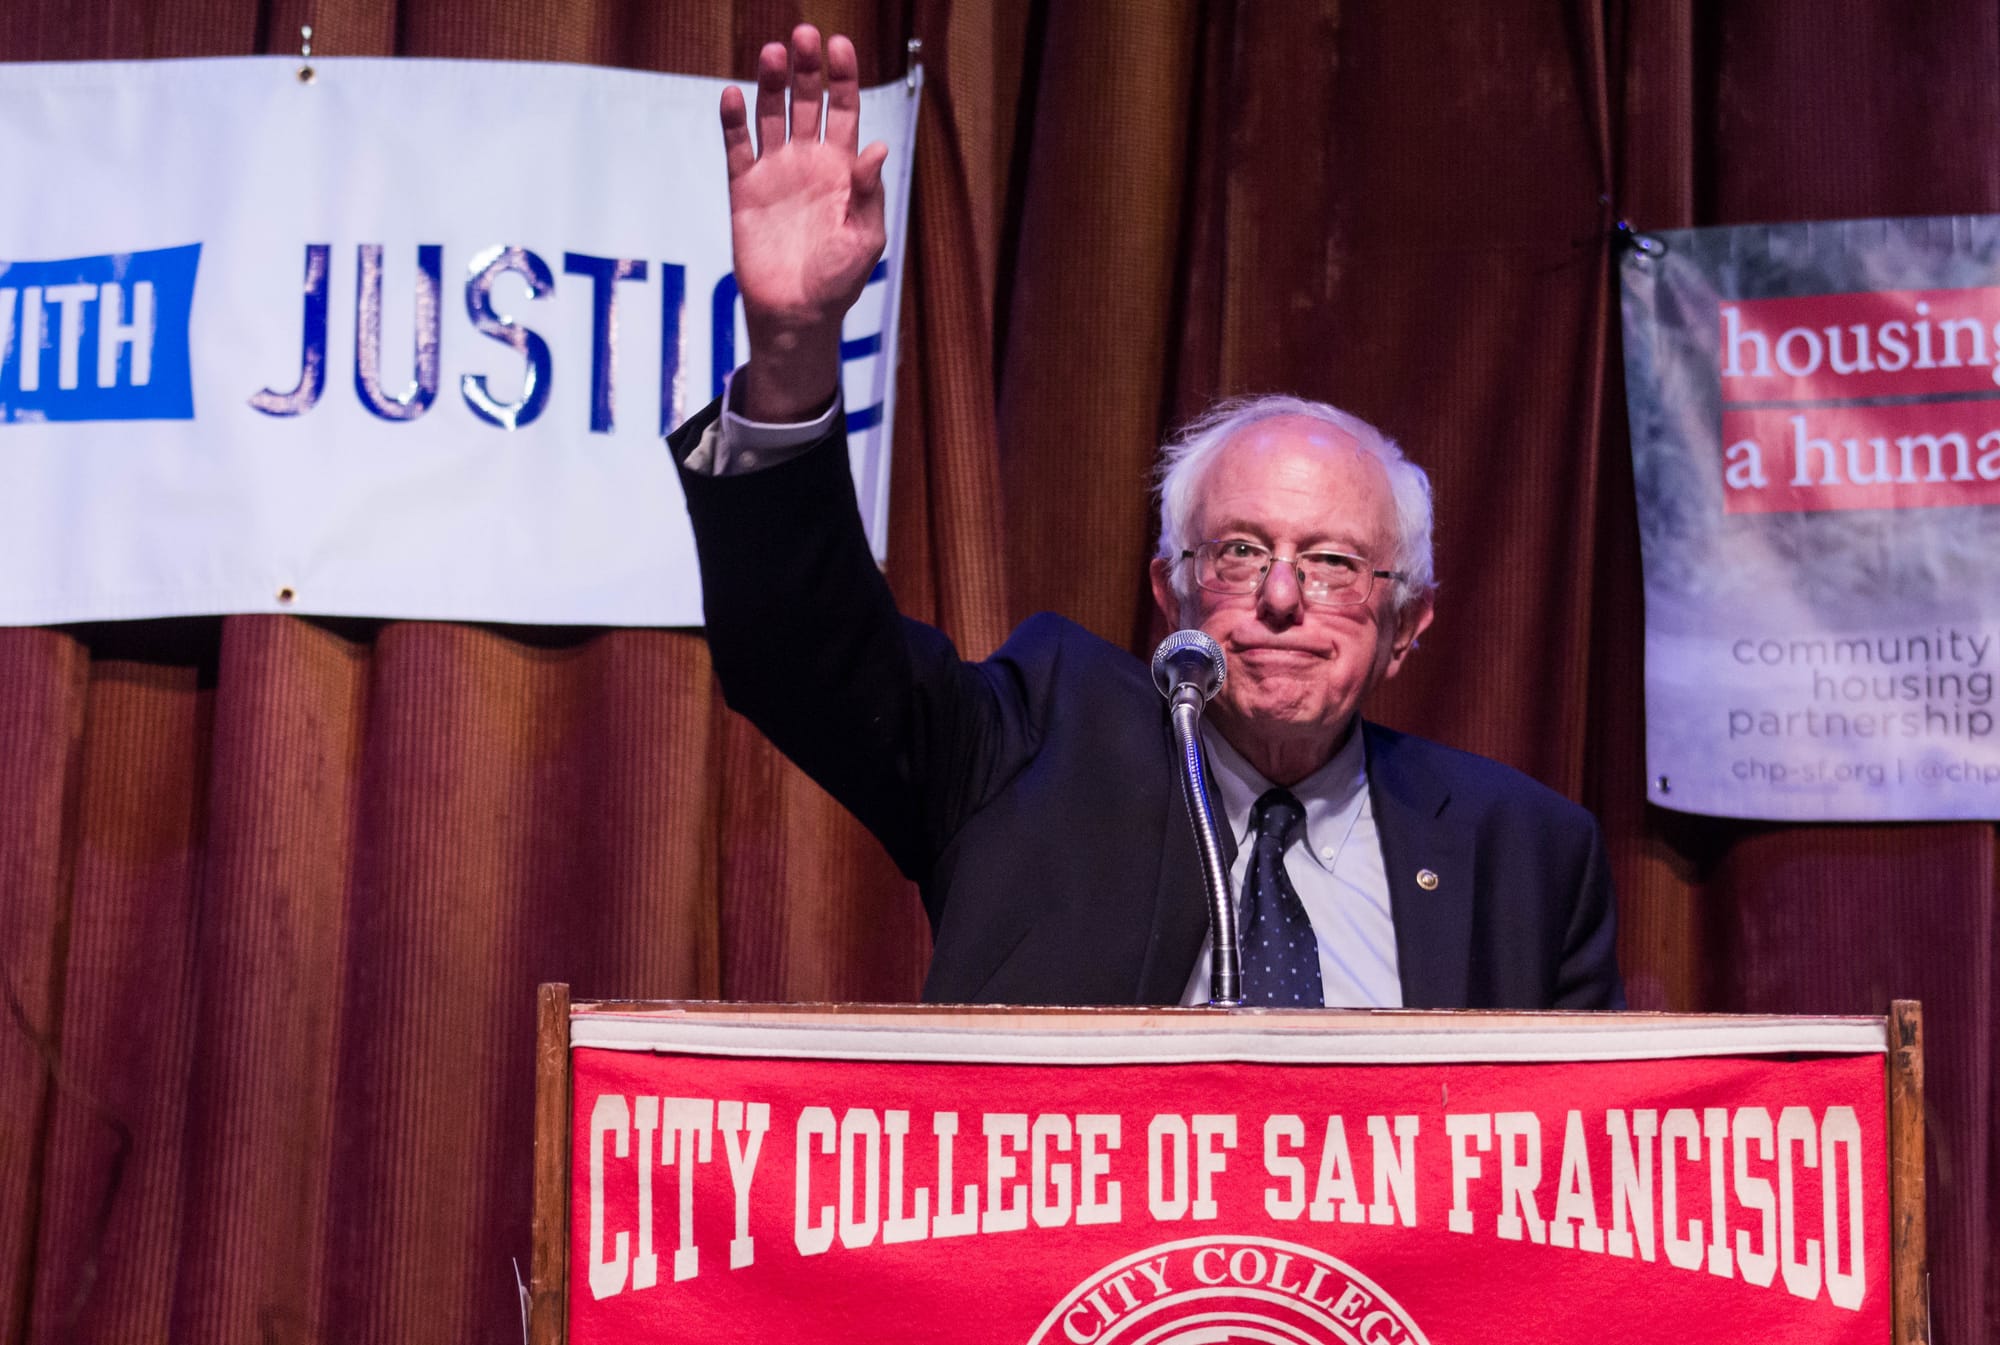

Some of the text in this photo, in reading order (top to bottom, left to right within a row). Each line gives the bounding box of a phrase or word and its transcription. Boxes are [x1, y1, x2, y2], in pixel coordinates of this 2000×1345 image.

[1721, 301, 2000, 387] housin
[1725, 439, 1768, 490] a
[1732, 627, 1990, 668] community
[1813, 666, 1992, 706] housing
[1728, 702, 1993, 743] partnership
[1731, 757, 1885, 785] chp-sf.org
[588, 1094, 1868, 1311] CITY COLLEGE OF SAN FRANCISCO
[1062, 1247, 1416, 1345] CITY COLLEG
